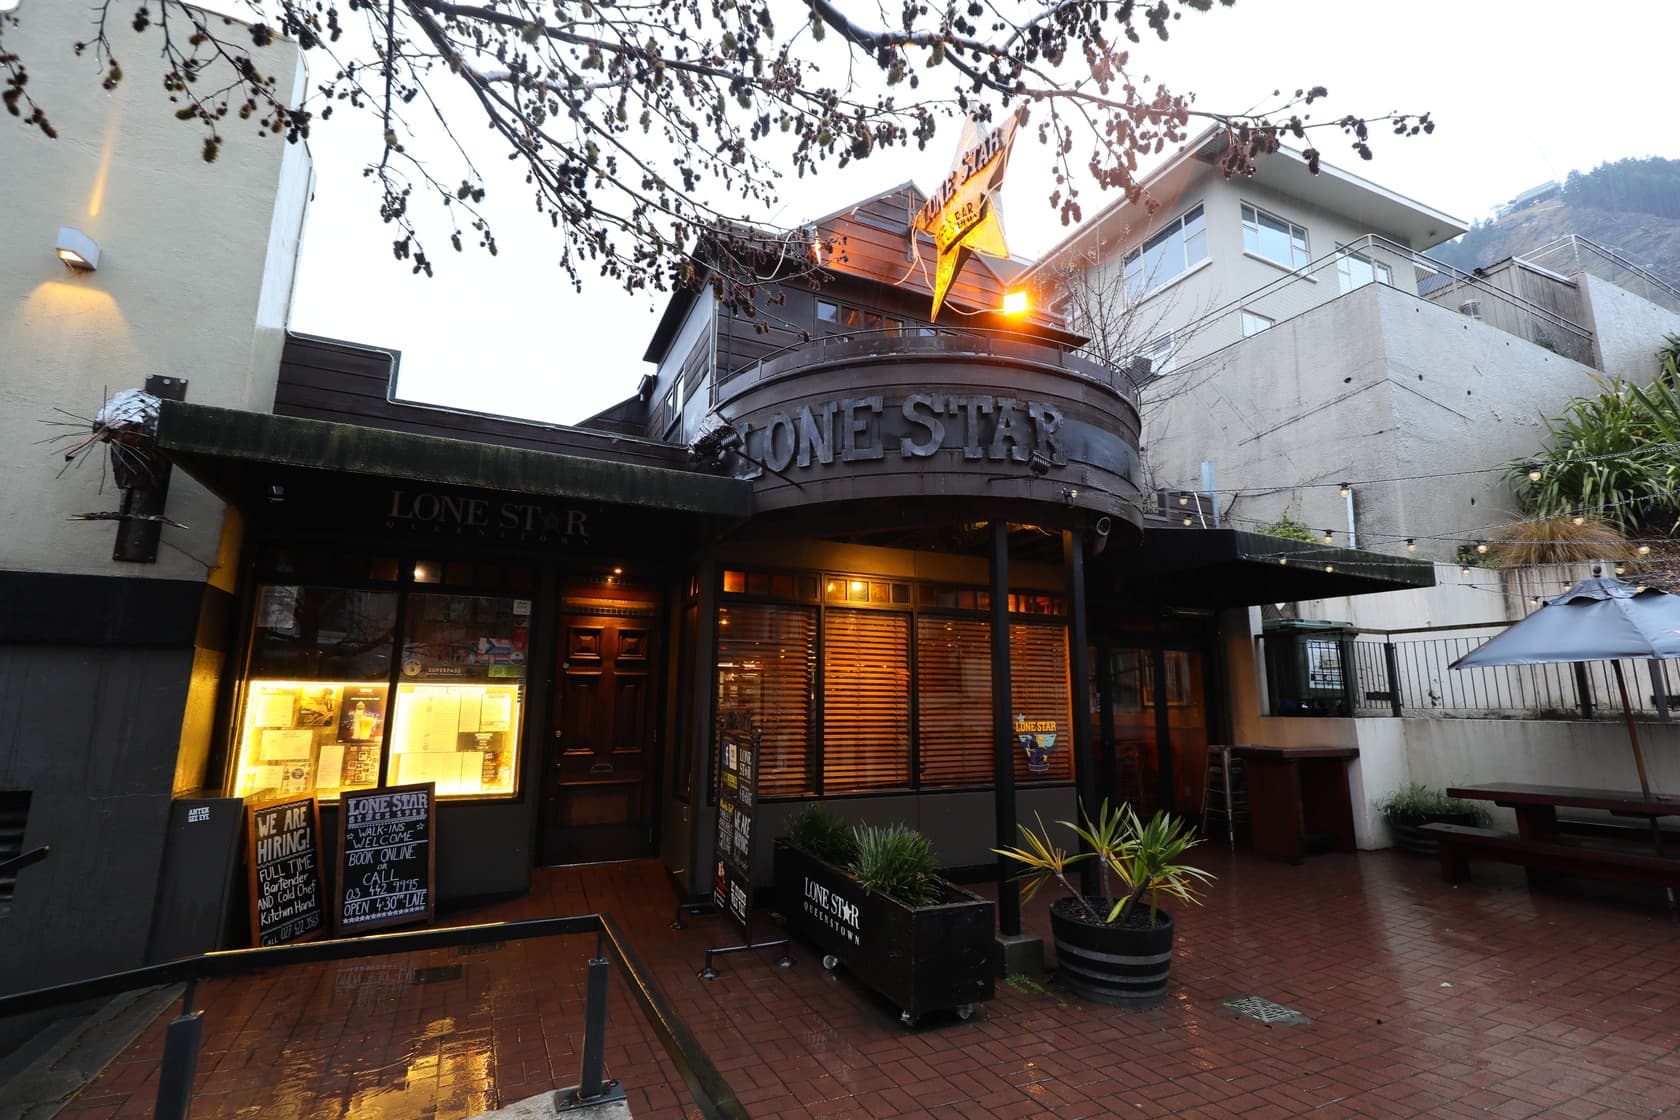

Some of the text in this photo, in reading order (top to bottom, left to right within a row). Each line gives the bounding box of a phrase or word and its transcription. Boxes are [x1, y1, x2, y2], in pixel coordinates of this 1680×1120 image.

[922, 171, 958, 230] LONE
[960, 127, 1006, 186] STAR
[735, 394, 1068, 481] LONE STAR
[387, 489, 488, 527] LONE
[1015, 721, 1056, 732] LONE STAR
[348, 793, 428, 816] LONE STAR
[257, 806, 307, 837] WE ARE
[358, 822, 406, 838] WALK-INS
[257, 826, 310, 865] HIRING!
[353, 830, 414, 849] WELCOME
[259, 854, 314, 884] FULL TIME
[348, 844, 418, 867] BOOK ONLINE
[263, 872, 309, 896] Bartender
[346, 888, 361, 901] 03
[369, 883, 388, 896] 442
[362, 869, 399, 886] CALL
[257, 880, 316, 912] AND Cold Chef
[343, 900, 370, 916] OPEN
[804, 876, 829, 910] LONE
[260, 895, 316, 927] Kitchen Hand
[803, 901, 860, 947] QUEENSTOWN
